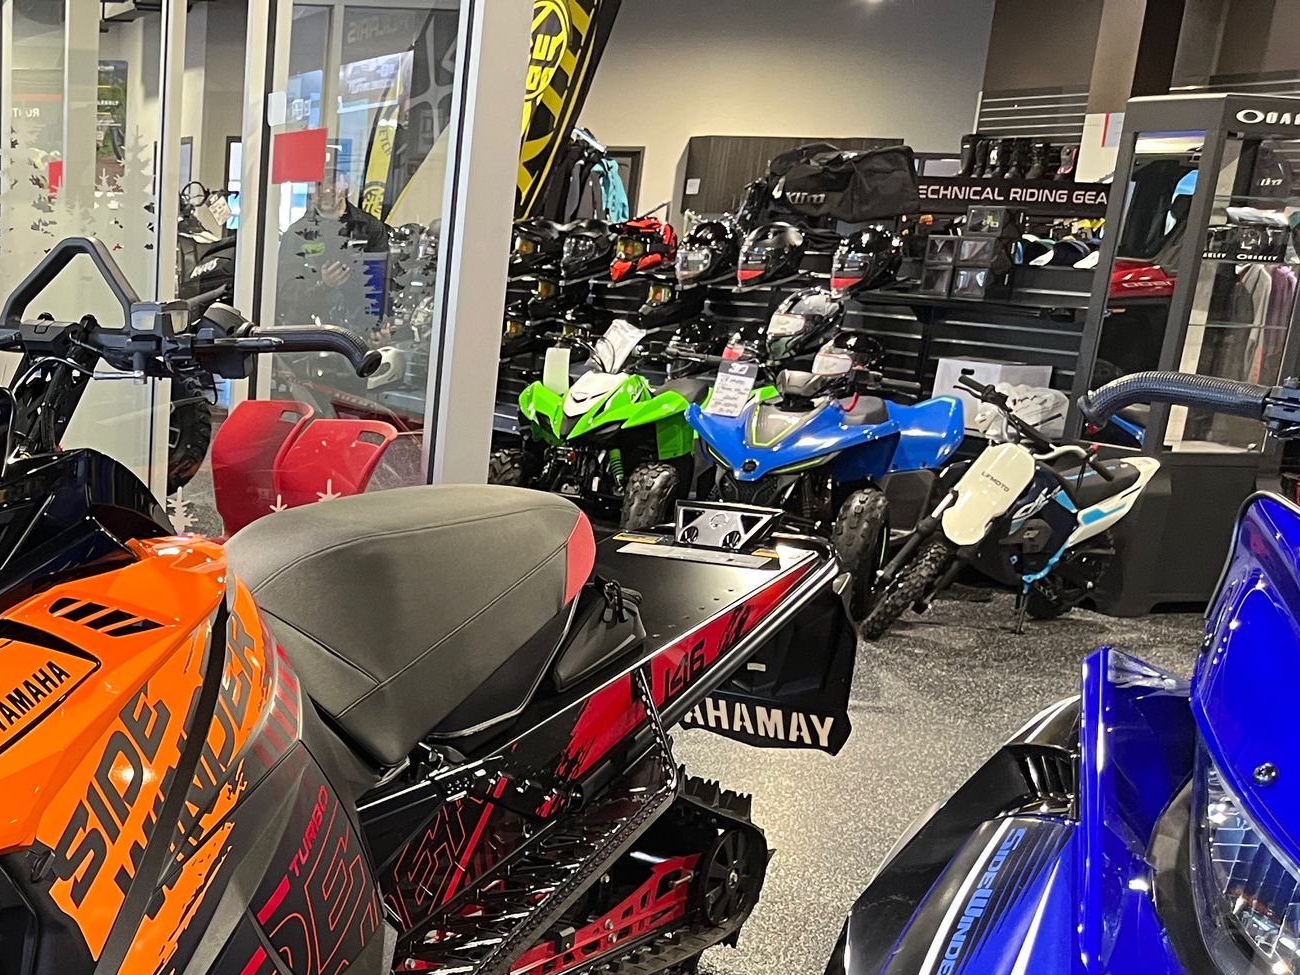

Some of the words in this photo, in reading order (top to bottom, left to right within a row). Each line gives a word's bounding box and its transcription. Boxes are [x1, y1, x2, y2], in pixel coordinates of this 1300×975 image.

[918, 185, 1004, 201] ECHNICAL
[1009, 188, 1068, 203] RIDING
[1072, 190, 1108, 205] GEA
[52, 678, 171, 911] SIDE
[289, 784, 329, 878] TURBO
